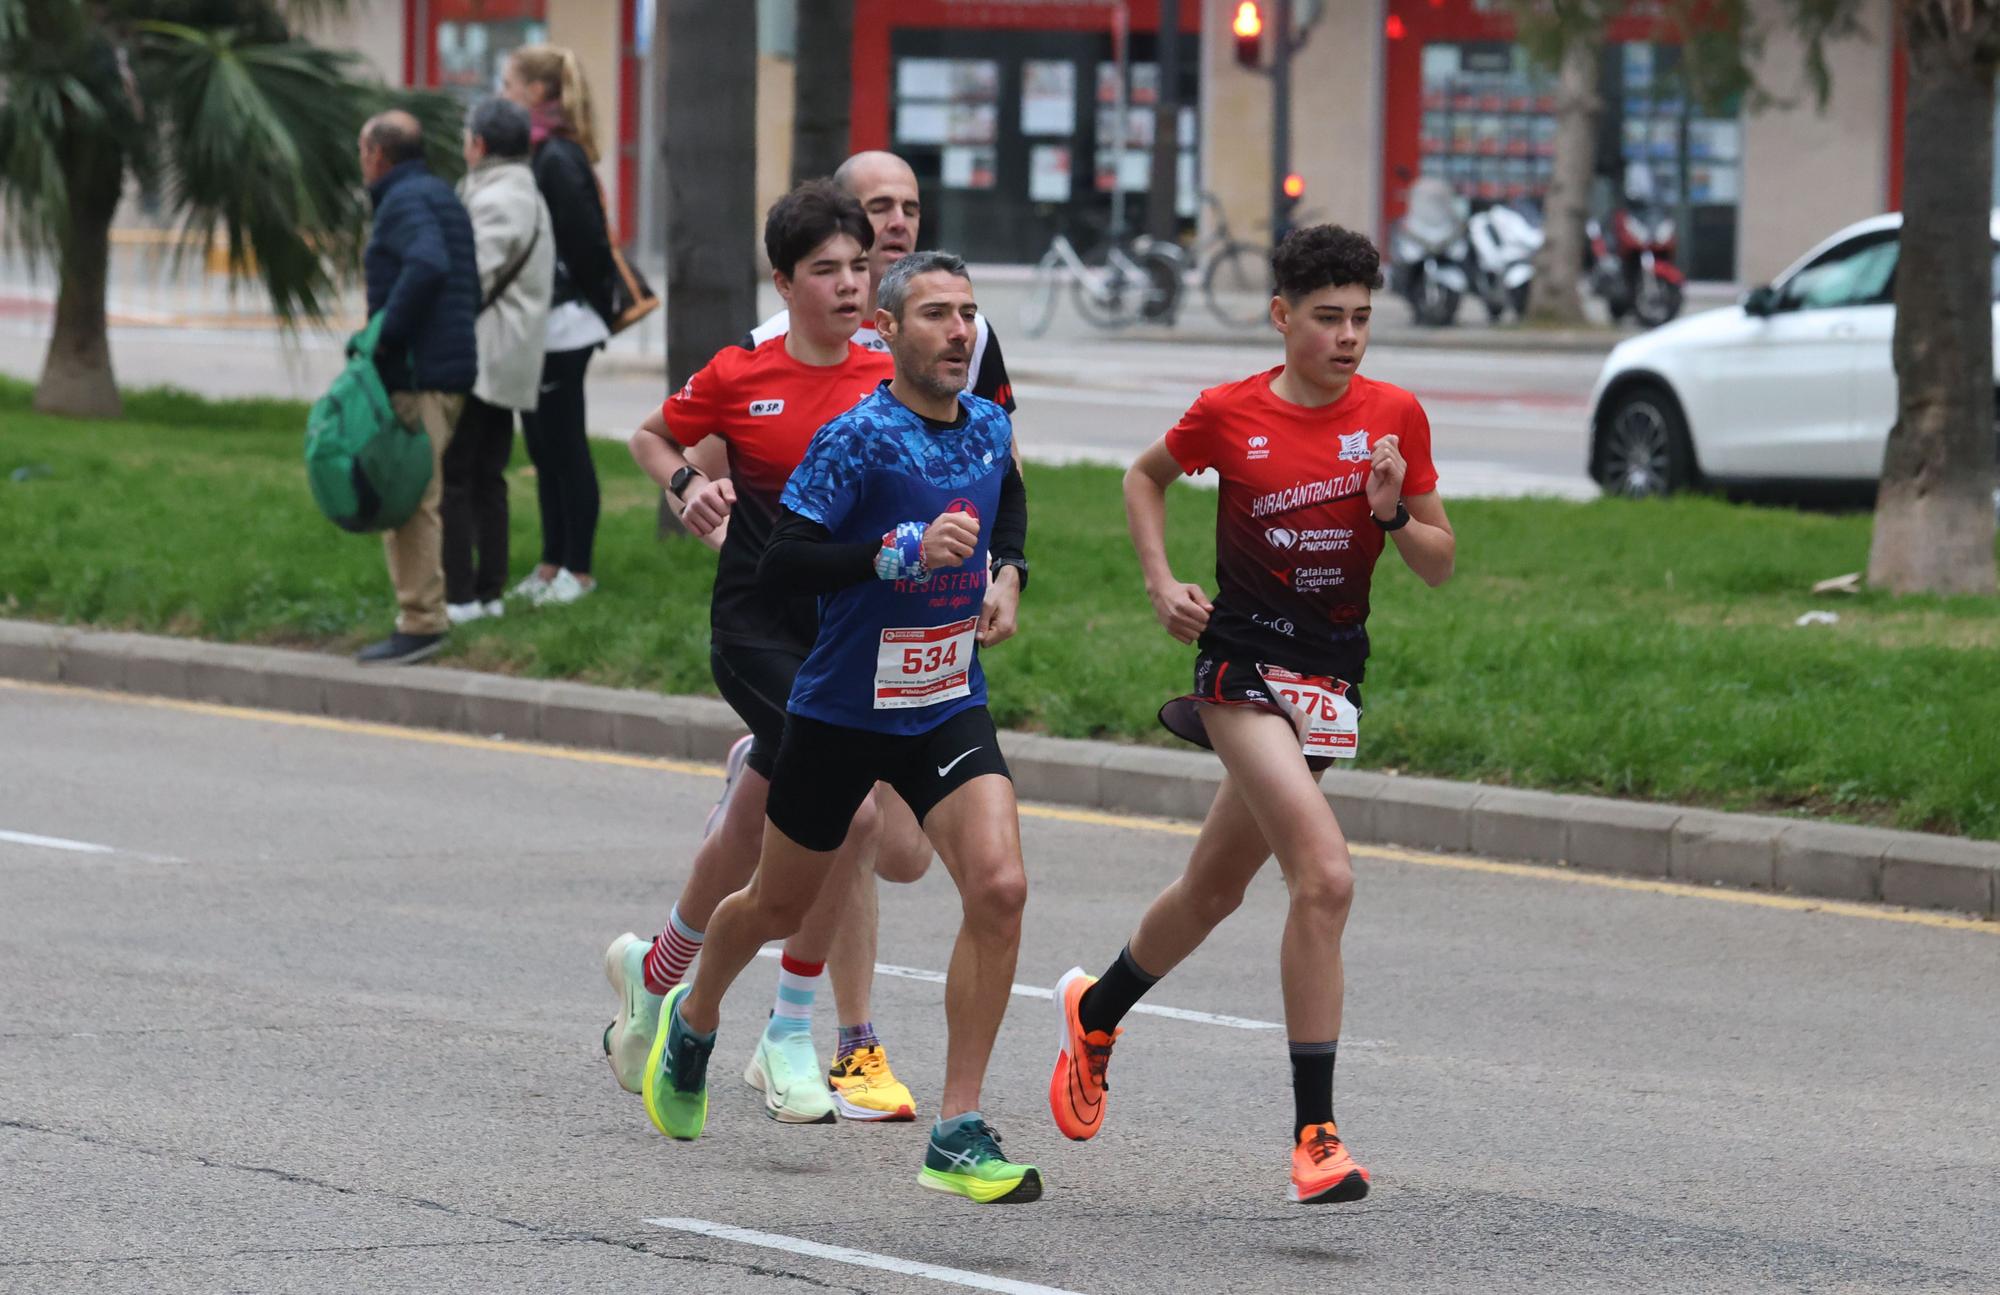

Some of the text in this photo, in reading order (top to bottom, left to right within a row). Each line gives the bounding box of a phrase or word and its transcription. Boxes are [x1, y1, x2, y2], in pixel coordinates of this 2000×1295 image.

[1251, 468, 1363, 517] HURACÁNTRIATLÓN
[1299, 529, 1353, 541] SPORTING
[1298, 540, 1349, 551] PURSUITS
[1295, 567, 1341, 578] Catalana
[902, 641, 957, 674] 534
